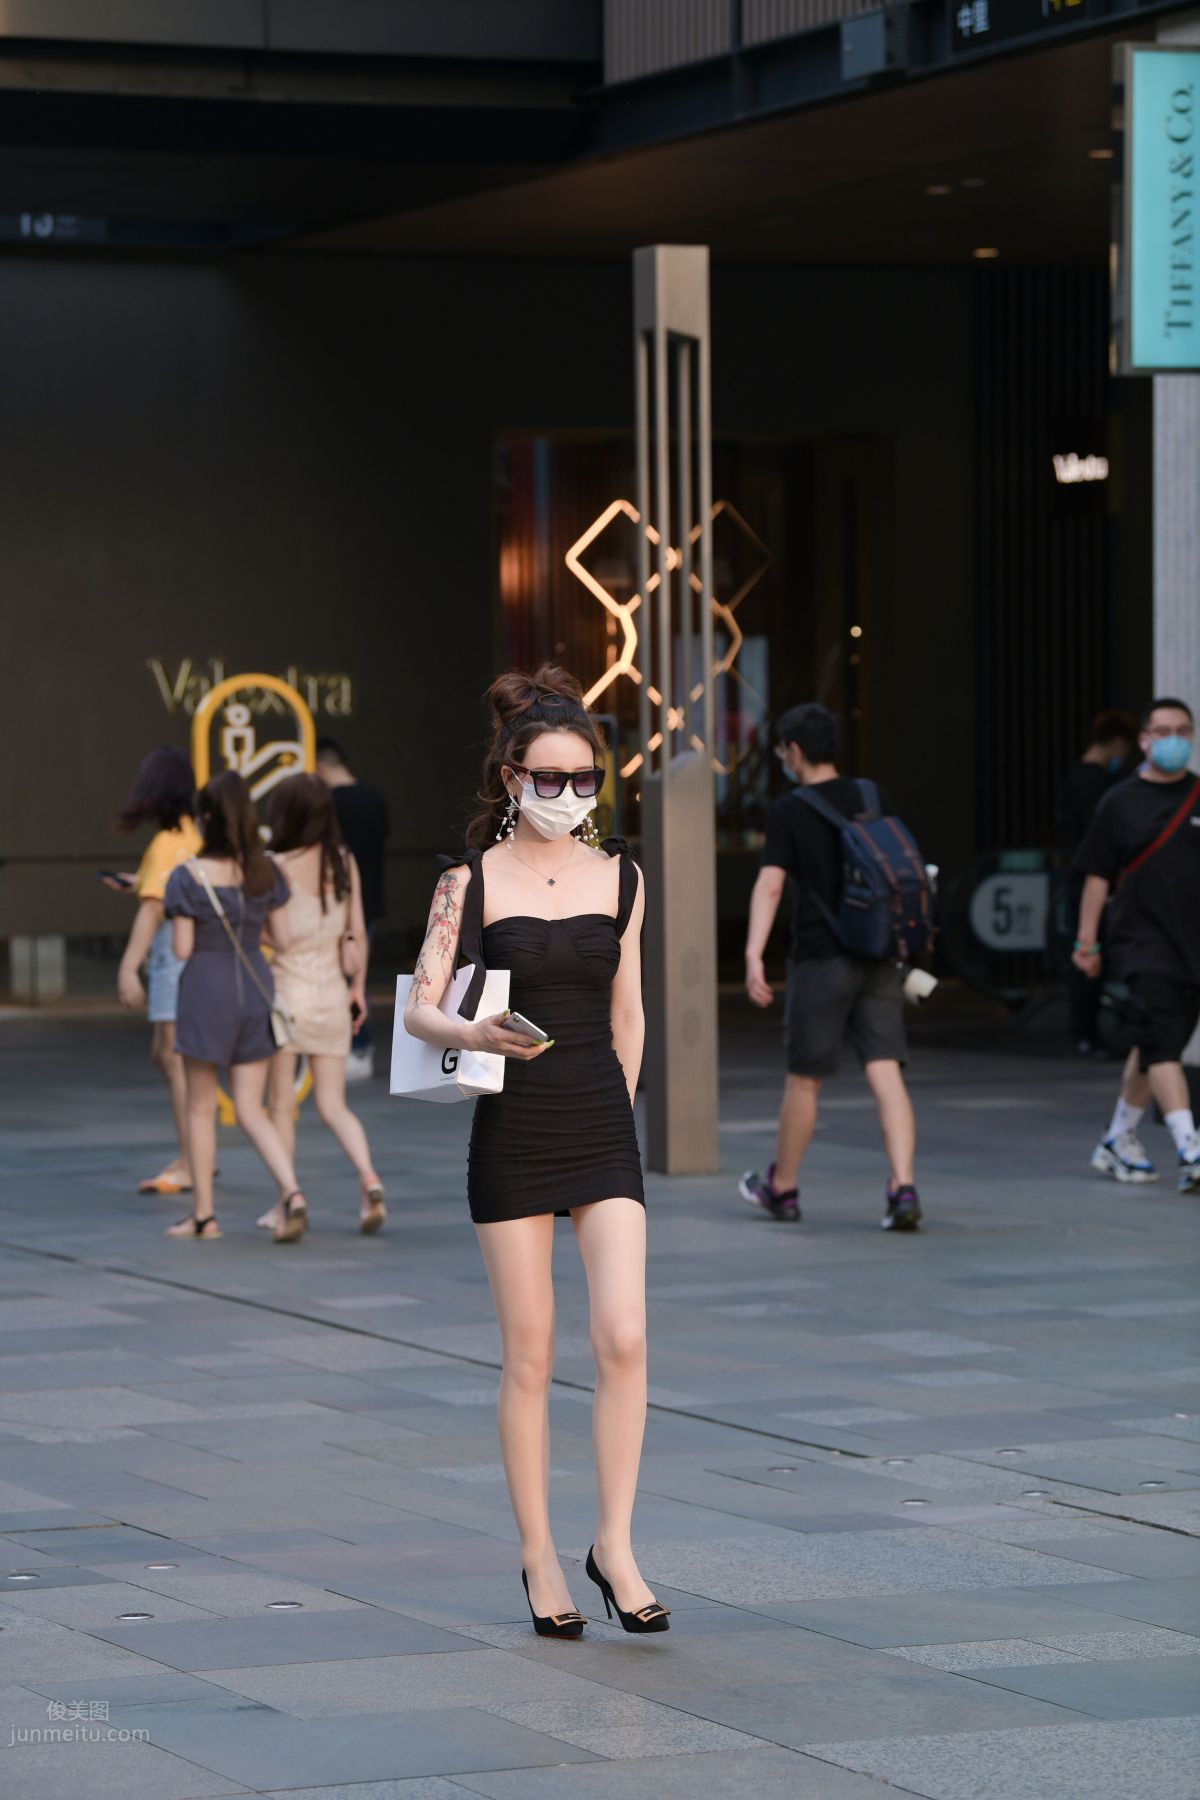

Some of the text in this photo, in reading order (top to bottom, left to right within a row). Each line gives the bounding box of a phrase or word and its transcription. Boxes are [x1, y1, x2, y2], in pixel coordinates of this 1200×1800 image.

[1164, 184, 1193, 338] TIFFANY
[993, 886, 1012, 935] 5
[441, 1047, 459, 1075] G
